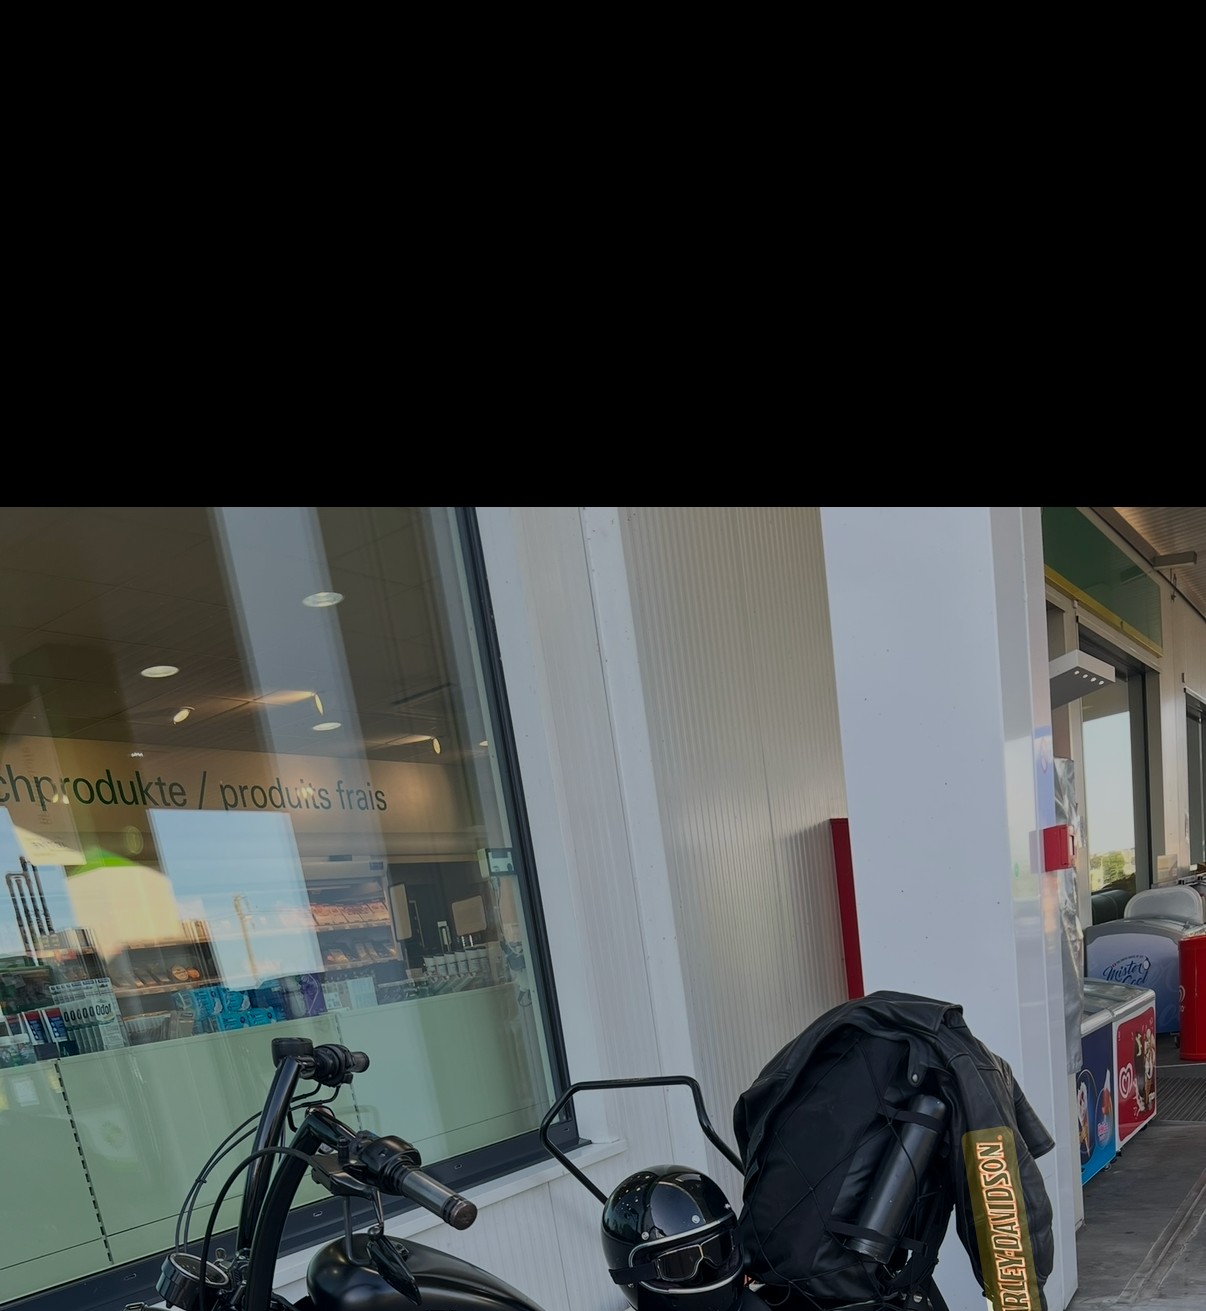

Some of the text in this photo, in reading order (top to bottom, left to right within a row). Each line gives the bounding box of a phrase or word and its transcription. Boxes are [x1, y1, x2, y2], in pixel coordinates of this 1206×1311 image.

[198, 771, 207, 809] /
[219, 777, 332, 813] produits
[336, 780, 387, 811] frais
[1103, 960, 1143, 982] Mister
